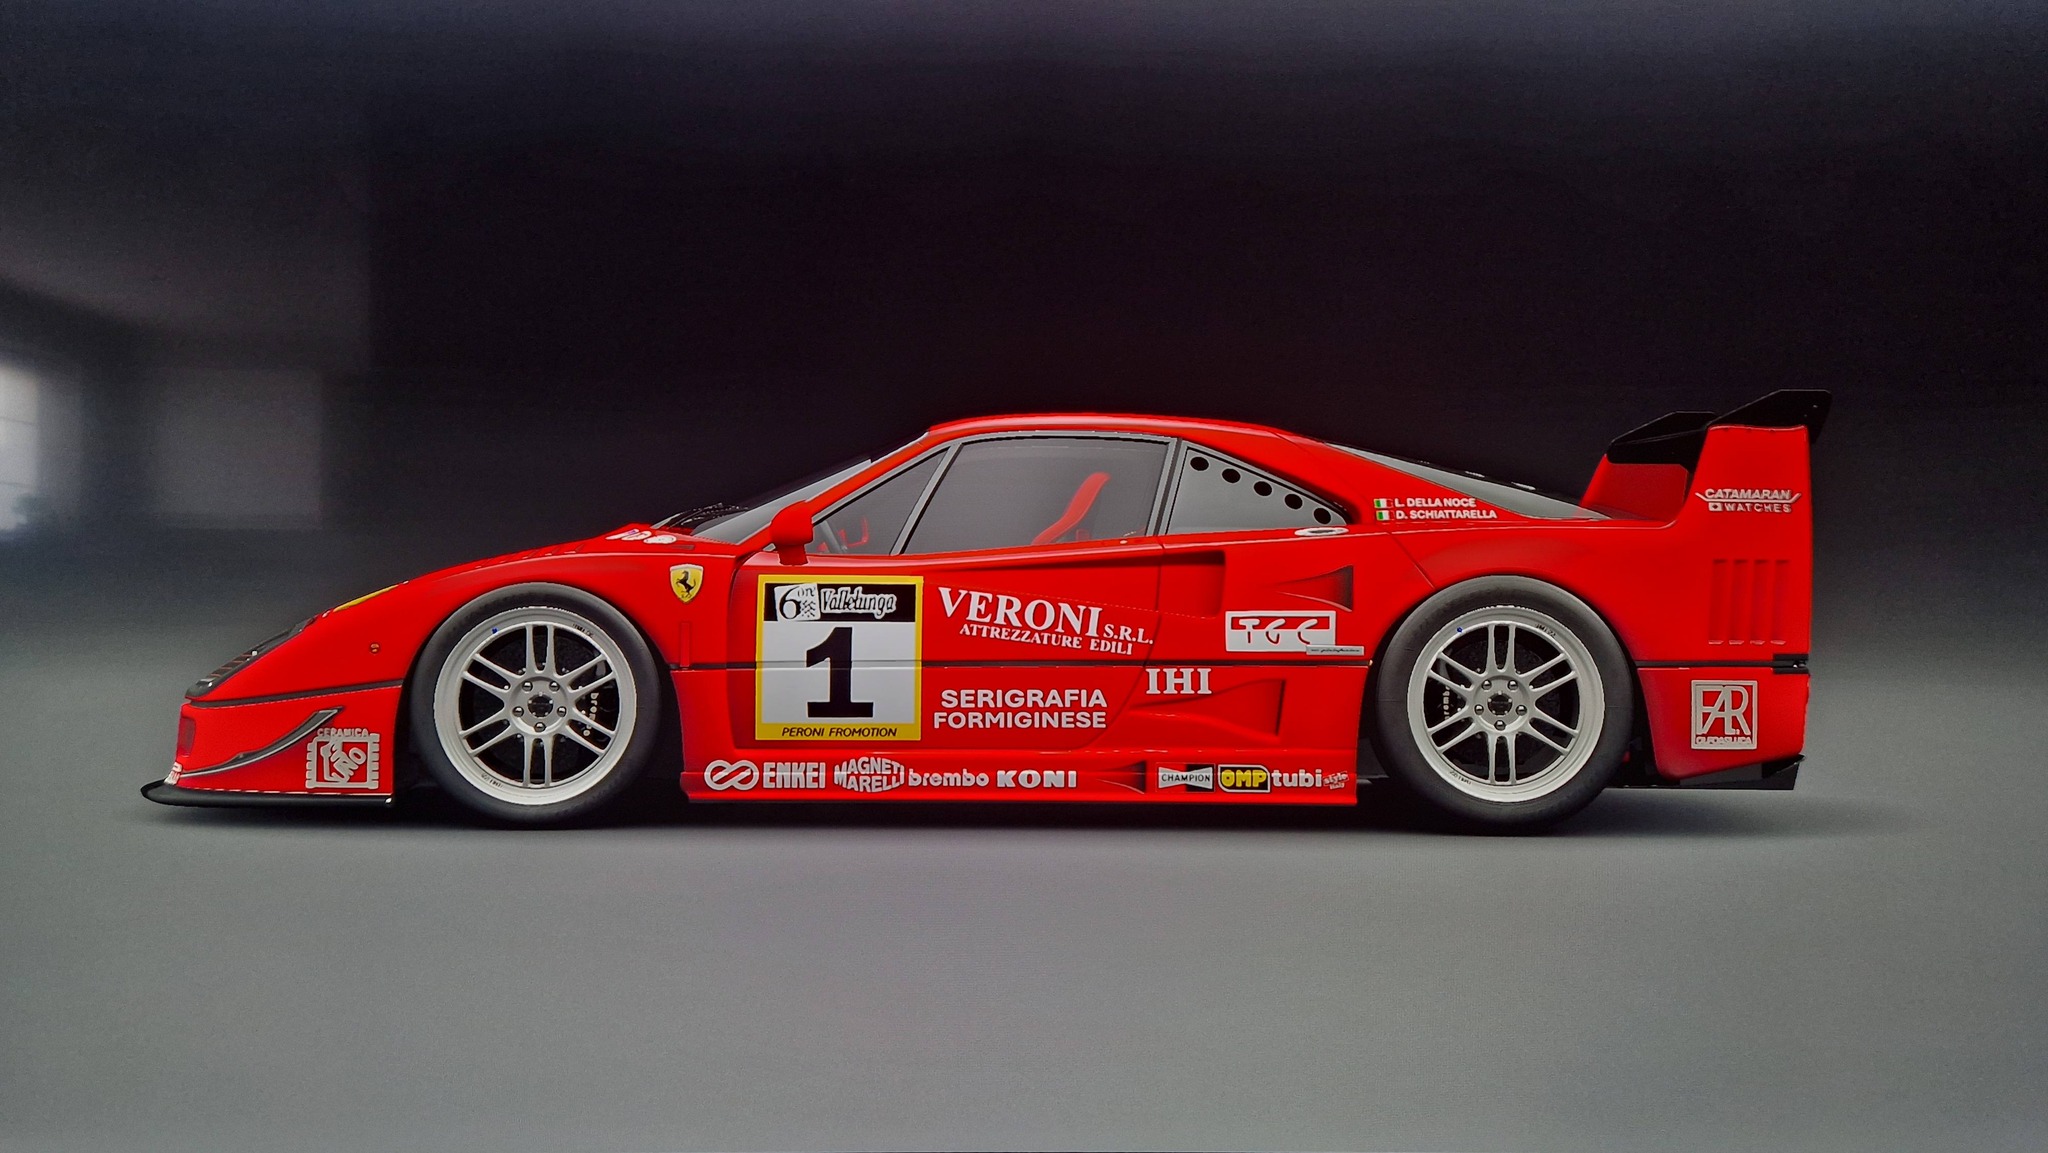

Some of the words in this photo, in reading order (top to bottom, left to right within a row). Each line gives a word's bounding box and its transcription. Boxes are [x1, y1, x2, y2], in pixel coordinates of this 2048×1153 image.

[1394, 498, 1405, 507] L.
[1406, 498, 1442, 507] DELLA
[1443, 498, 1476, 507] NOCE
[1705, 488, 1791, 500] CATAMARAN
[1395, 510, 1408, 519] D.
[1409, 510, 1497, 519] SCHIATTARELLA
[1724, 503, 1792, 512] WATCHES
[779, 585, 801, 619] 6
[938, 586, 1103, 638] VERONI
[1103, 623, 1154, 645] S.R.L.
[959, 623, 1083, 649] ATTREZZATURE
[1089, 638, 1133, 656] EDILI
[806, 627, 874, 718] 1
[1145, 668, 1212, 695] IHI
[941, 689, 1108, 708] SERIGRAFIA
[933, 711, 1107, 728] FORMIGINESE
[782, 727, 825, 738] PERONI
[829, 727, 898, 738] FROMOTION
[763, 762, 826, 788] ENKEI
[908, 768, 990, 787] brembo
[996, 770, 1077, 788] KONI
[1161, 773, 1211, 782] CHAMPION
[1221, 769, 1267, 788] OMP
[1272, 769, 1322, 788] tubi
